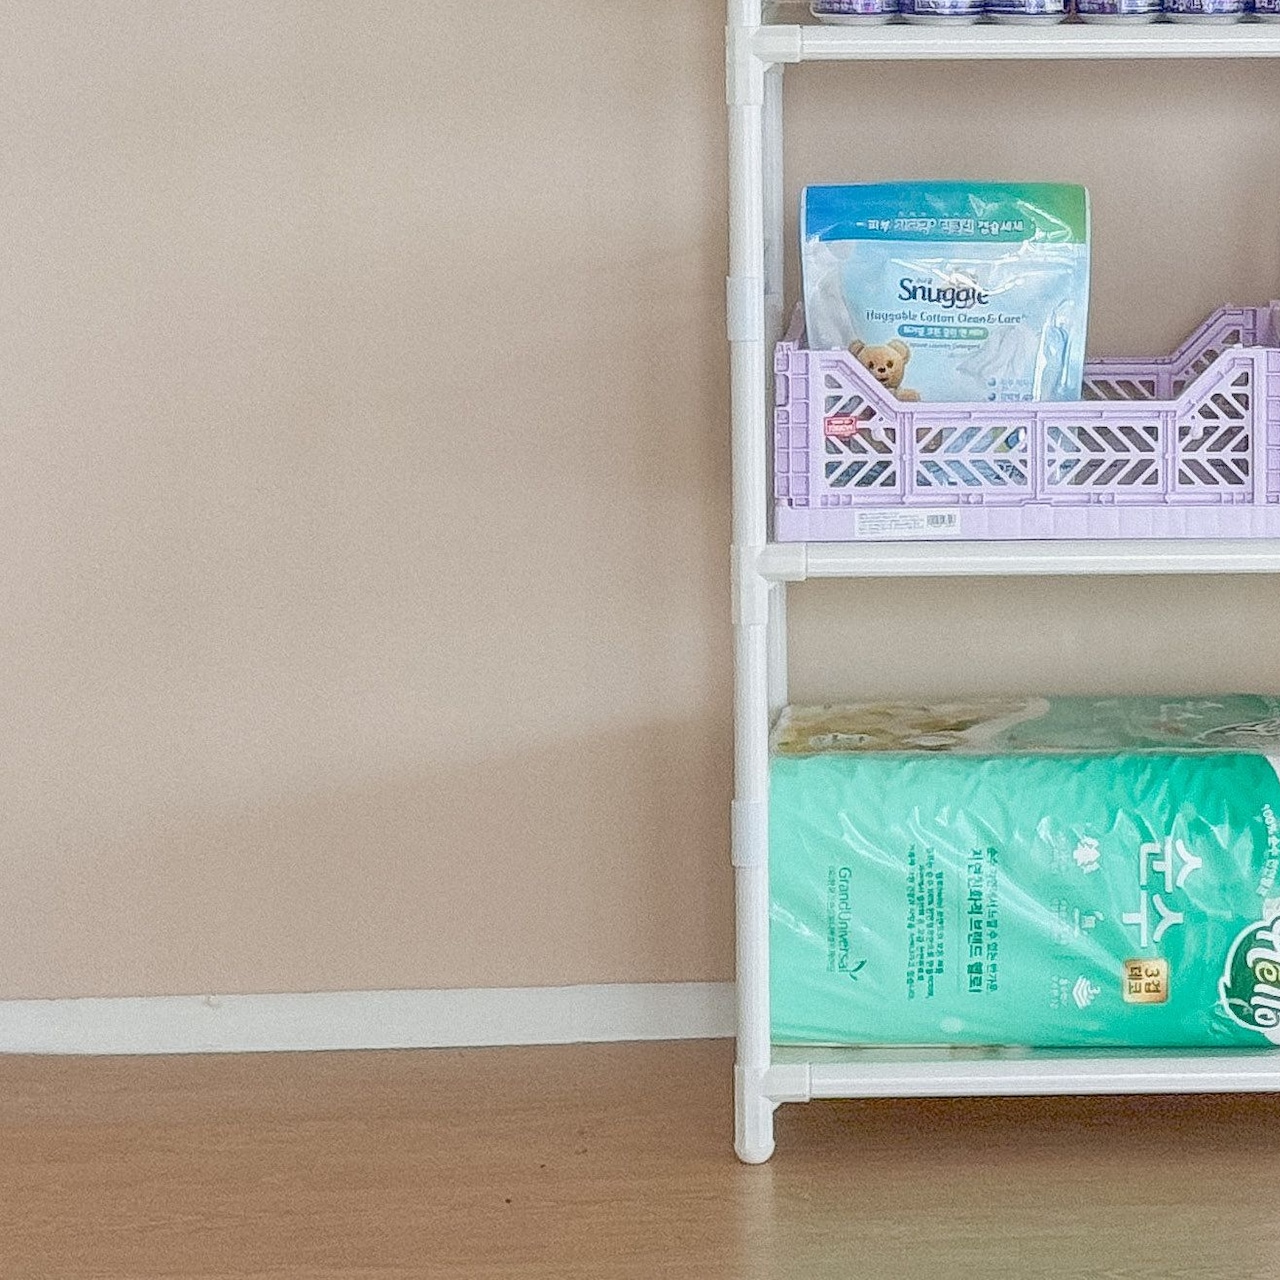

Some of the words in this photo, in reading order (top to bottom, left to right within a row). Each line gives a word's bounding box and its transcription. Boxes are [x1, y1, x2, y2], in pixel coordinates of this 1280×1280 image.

[898, 277, 990, 309] Snuggle
[920, 311, 954, 323] Cotton
[1121, 834, 1202, 947] 순수
[966, 917, 984, 959] 브랜드
[985, 930, 998, 940] 수
[985, 941, 998, 961] 있는
[1126, 966, 1142, 995] 데코
[1143, 967, 1160, 995] 3겹
